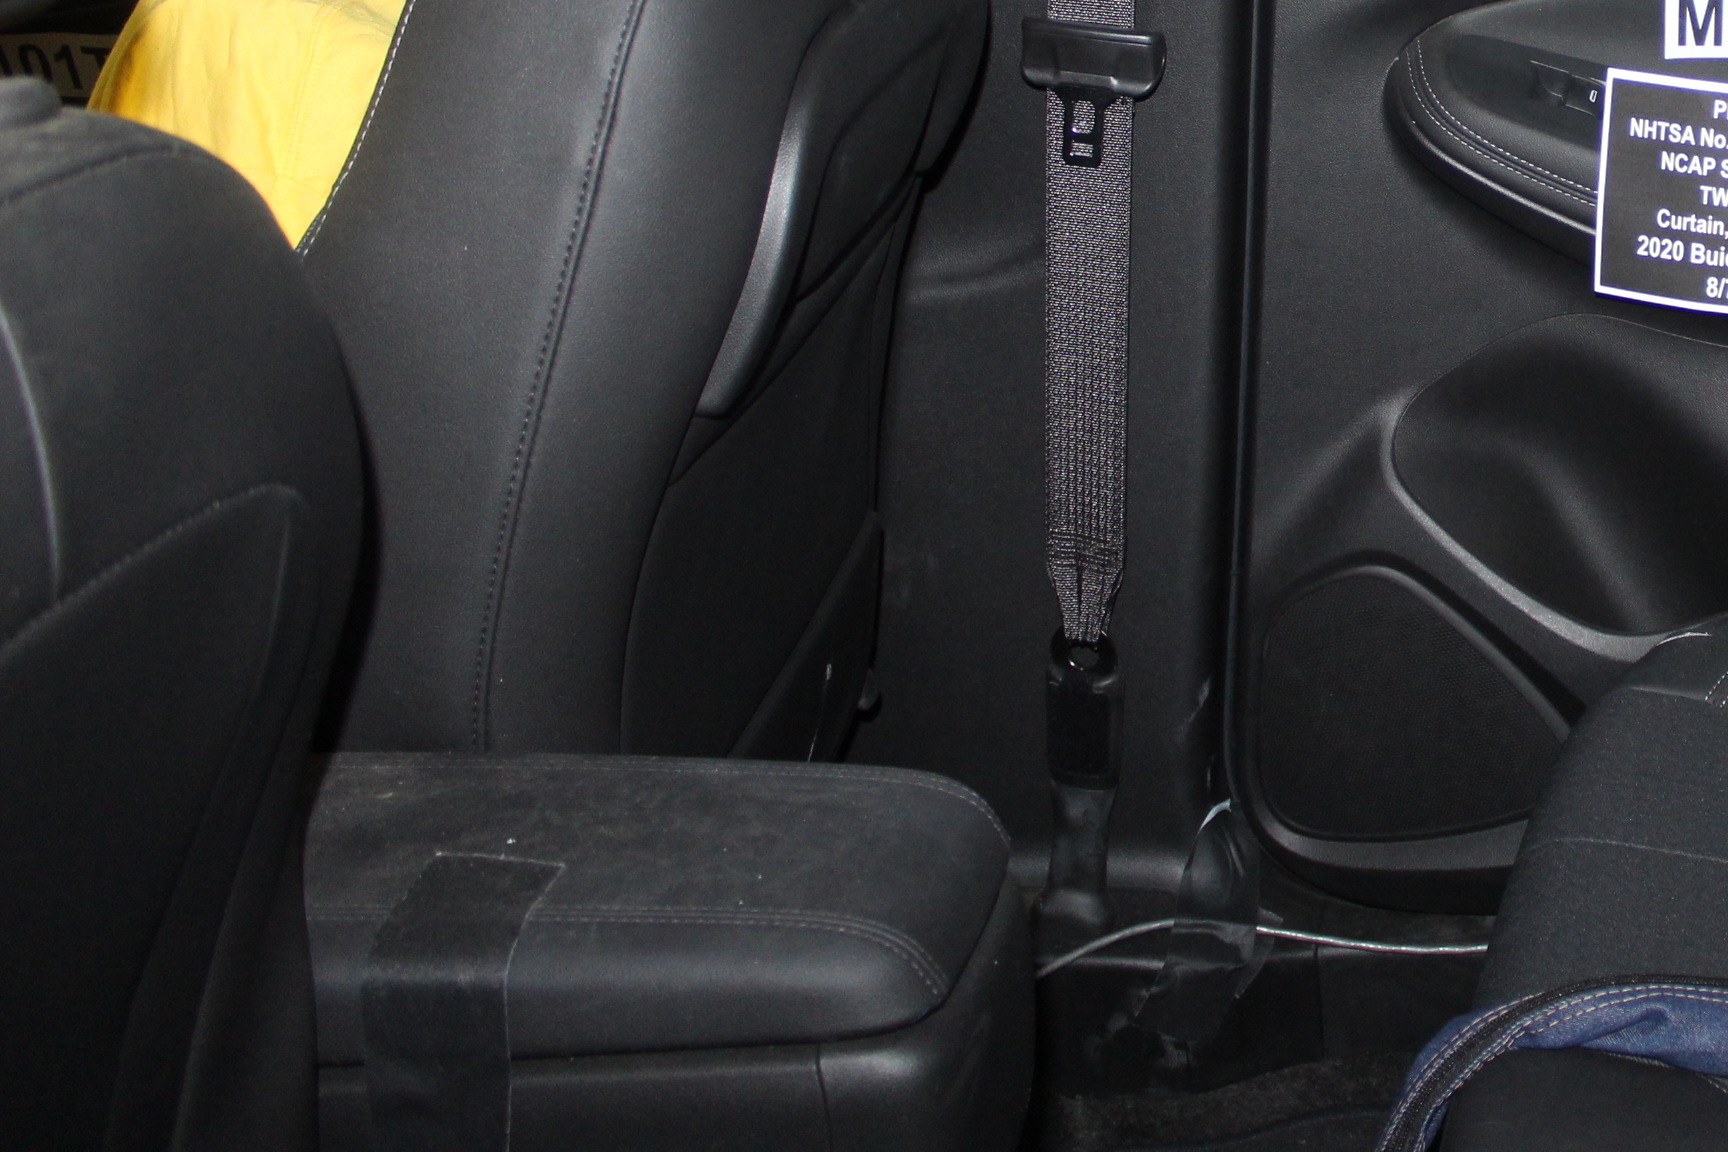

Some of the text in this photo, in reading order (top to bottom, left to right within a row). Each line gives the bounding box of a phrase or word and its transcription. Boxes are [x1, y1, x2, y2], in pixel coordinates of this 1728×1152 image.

[1630, 117, 1695, 145] NHTSA
[1661, 151, 1716, 176] NCAP
[1636, 235, 1684, 261] 2020
